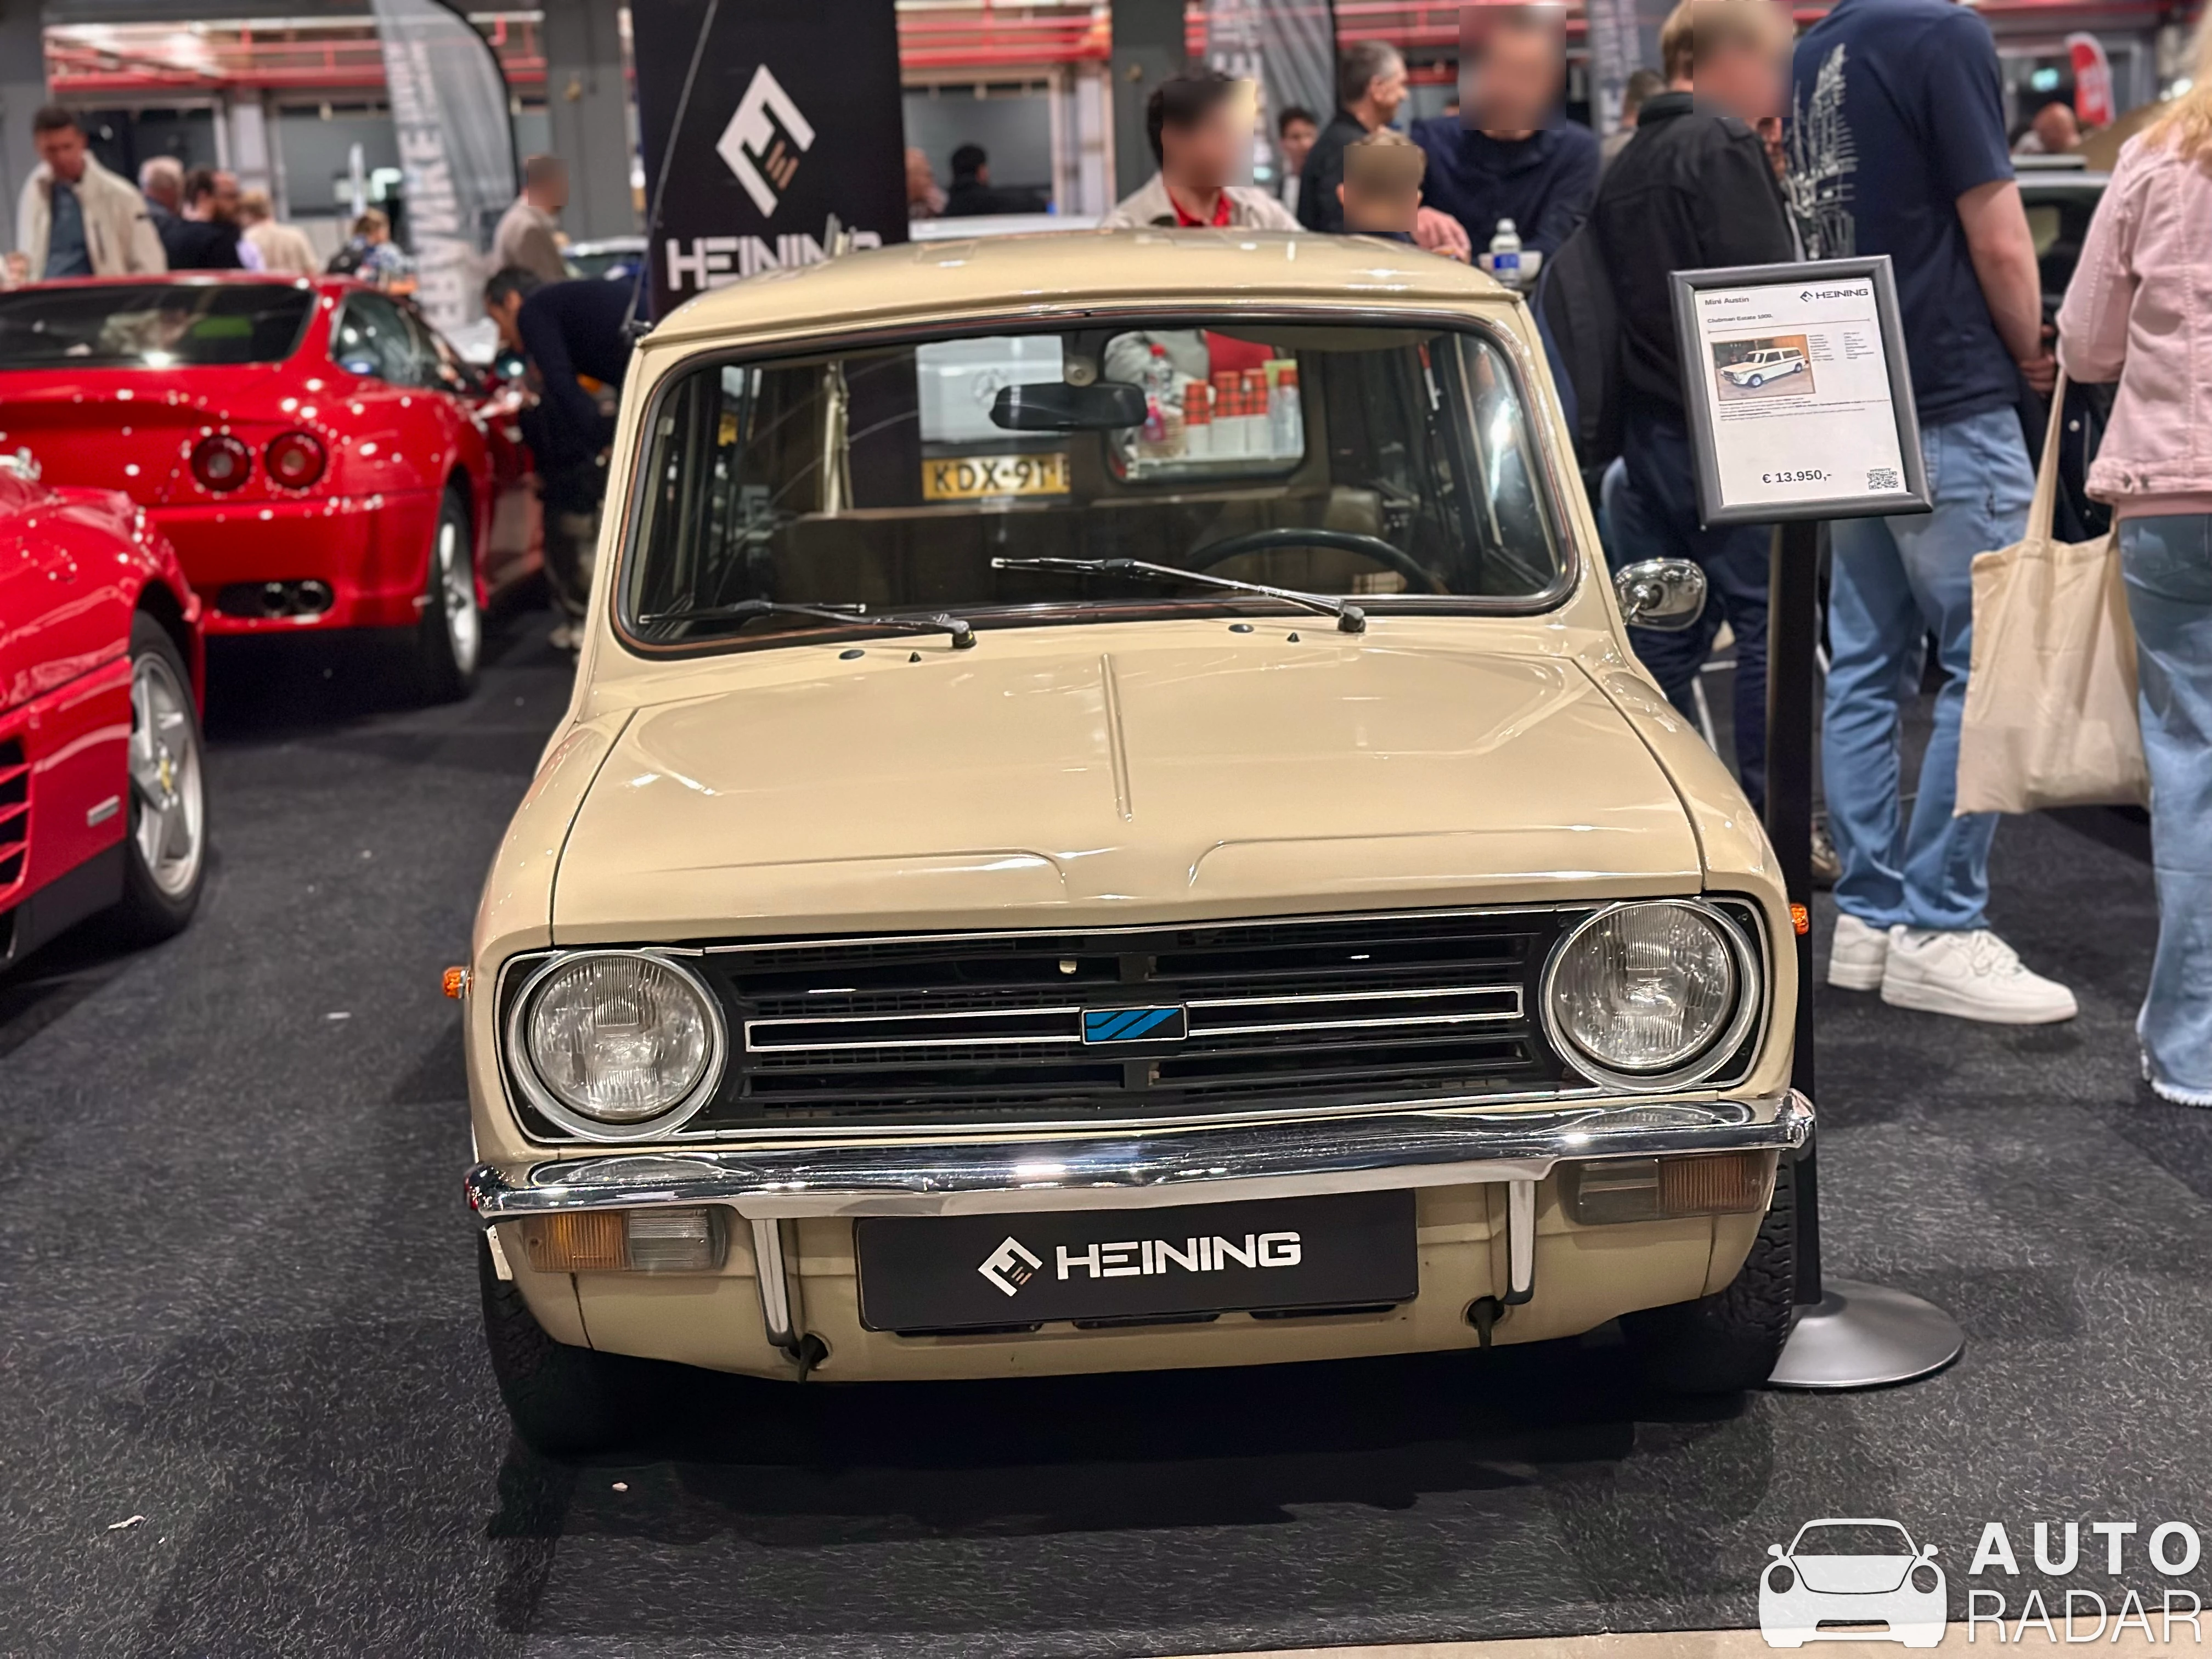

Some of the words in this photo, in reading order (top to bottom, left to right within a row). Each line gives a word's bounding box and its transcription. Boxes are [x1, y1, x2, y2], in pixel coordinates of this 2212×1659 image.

[1815, 289, 1869, 300] HEINING
[1762, 473, 1771, 483] €
[1775, 469, 1832, 483] 13.950,-
[1056, 1232, 1302, 1280] HEINING
